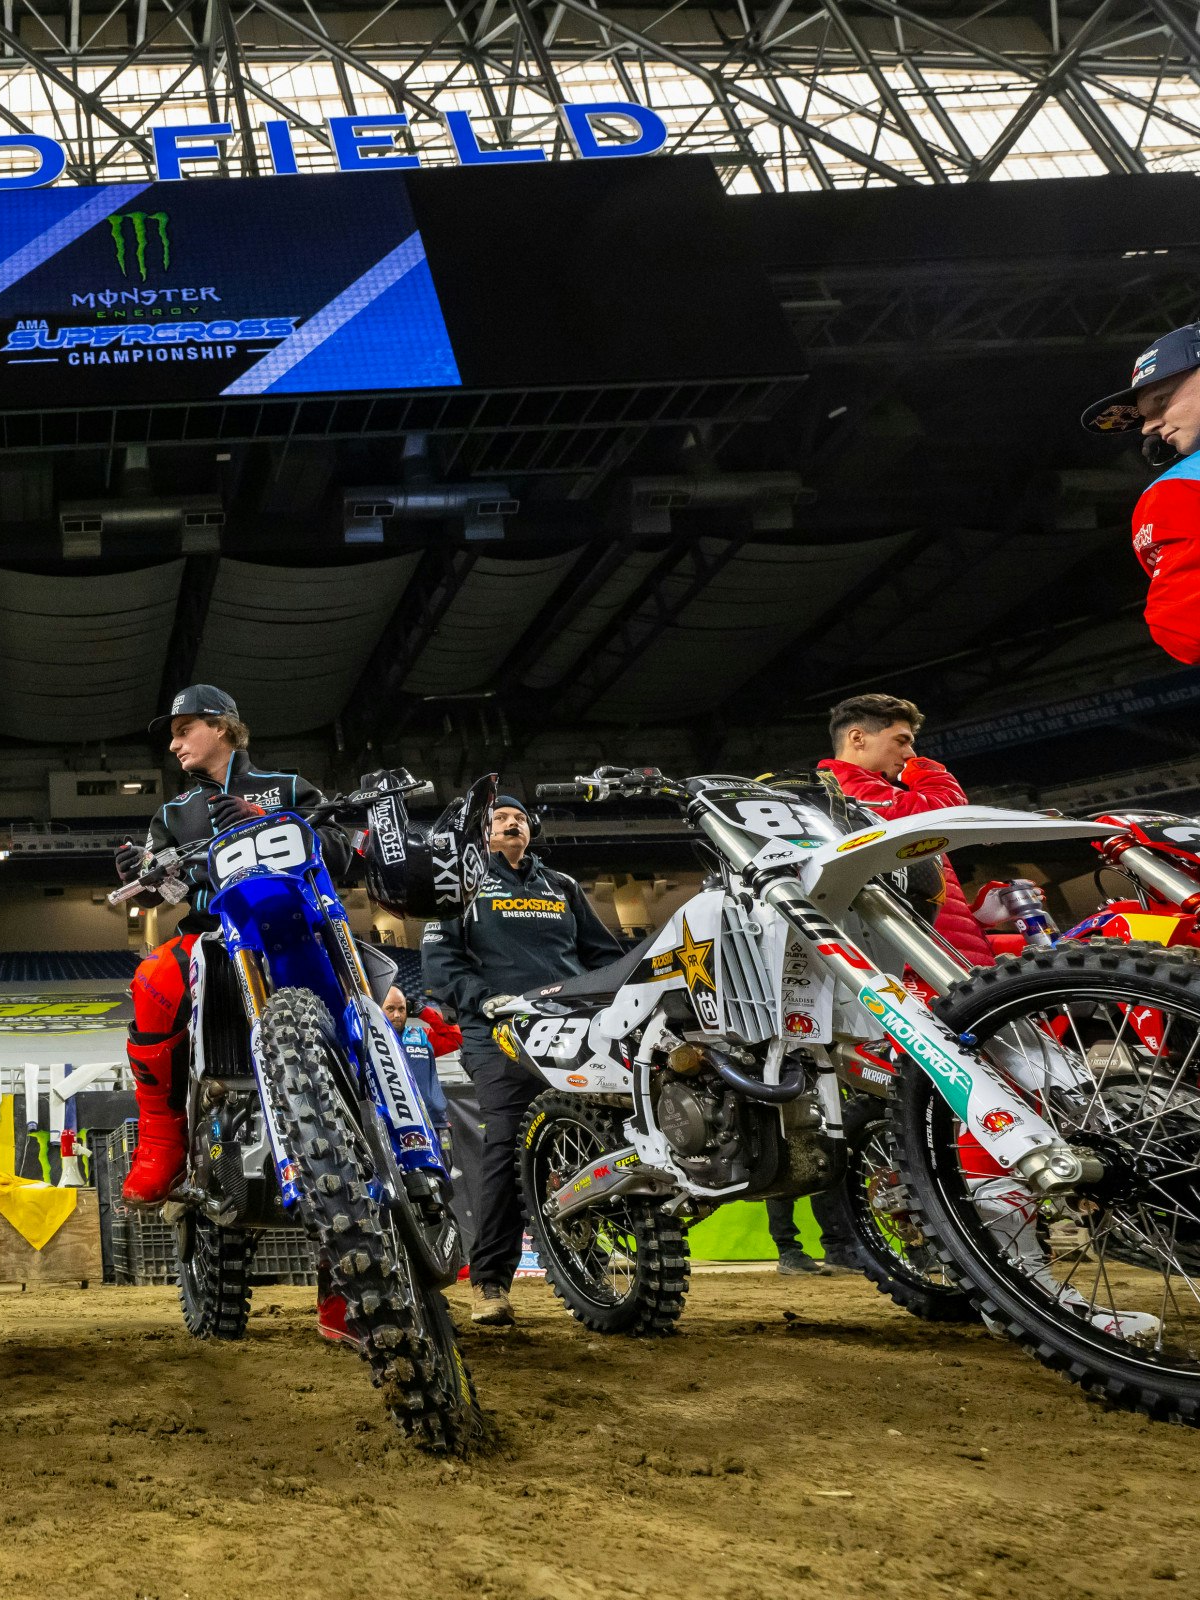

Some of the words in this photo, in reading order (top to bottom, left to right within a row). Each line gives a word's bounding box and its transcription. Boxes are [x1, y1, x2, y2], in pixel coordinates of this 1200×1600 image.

[147, 101, 669, 181] FIELD
[71, 286, 222, 309] MONSTER
[96, 306, 200, 319] ENERGY
[0, 316, 300, 351] SUPERCROSS
[15, 319, 49, 330] AMA
[68, 345, 238, 366] CHAMPIONSHIP
[244, 787, 280, 803] FXR
[215, 823, 307, 879] 99
[902, 837, 946, 858] FMF
[432, 832, 461, 905] FXR
[492, 898, 566, 914] ROCKSTAR
[406, 1045, 429, 1054] GAS
[524, 1018, 591, 1060] 83
[881, 1011, 968, 1086] MOTOREX
[369, 1025, 414, 1122] DUNLOP
[525, 1112, 546, 1147] DUNLOP
[926, 1124, 934, 1149] EXCEL
[615, 1153, 640, 1168] EXCEL
[593, 1165, 611, 1180] RK
